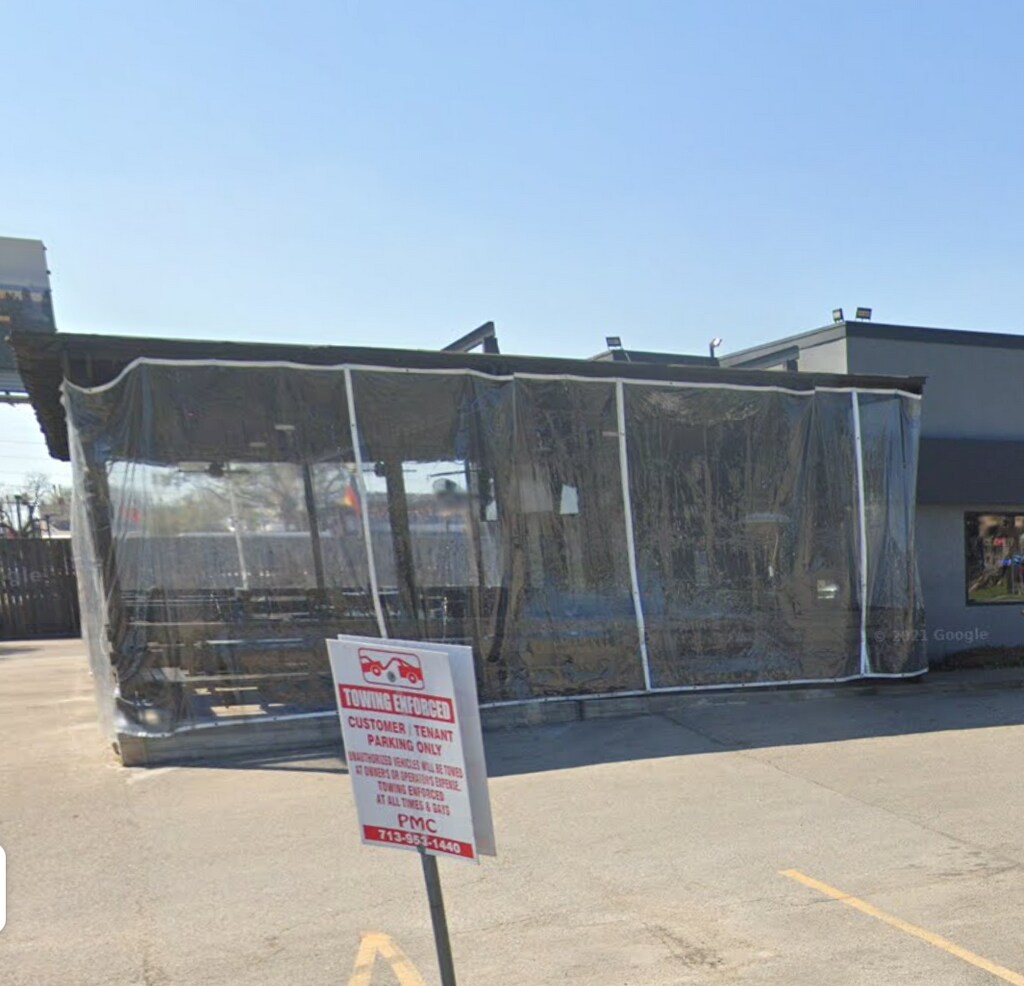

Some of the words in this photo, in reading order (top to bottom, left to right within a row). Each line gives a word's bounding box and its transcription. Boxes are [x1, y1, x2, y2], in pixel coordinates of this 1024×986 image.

[344, 689, 391, 709] TOWING
[395, 696, 450, 719] ENFORCED
[348, 716, 406, 734] CUSTOMER
[414, 725, 453, 742] TENANT
[368, 734, 414, 751] PARKING
[417, 740, 442, 756] ONLY
[348, 751, 392, 767] UNAUTHORIZED
[394, 757, 420, 771] VEHICLES
[422, 761, 434, 773] WILL
[436, 764, 443, 774] BE
[444, 765, 463, 778] TOWED
[355, 766, 363, 777] AT
[392, 771, 400, 781] OR
[378, 781, 407, 795] TOWING
[408, 786, 445, 801] ENFORCED
[376, 793, 386, 805] AT
[388, 796, 401, 807] ALL
[402, 799, 424, 812] TIMES
[433, 803, 451, 816] DAYS
[398, 813, 438, 834] PMC
